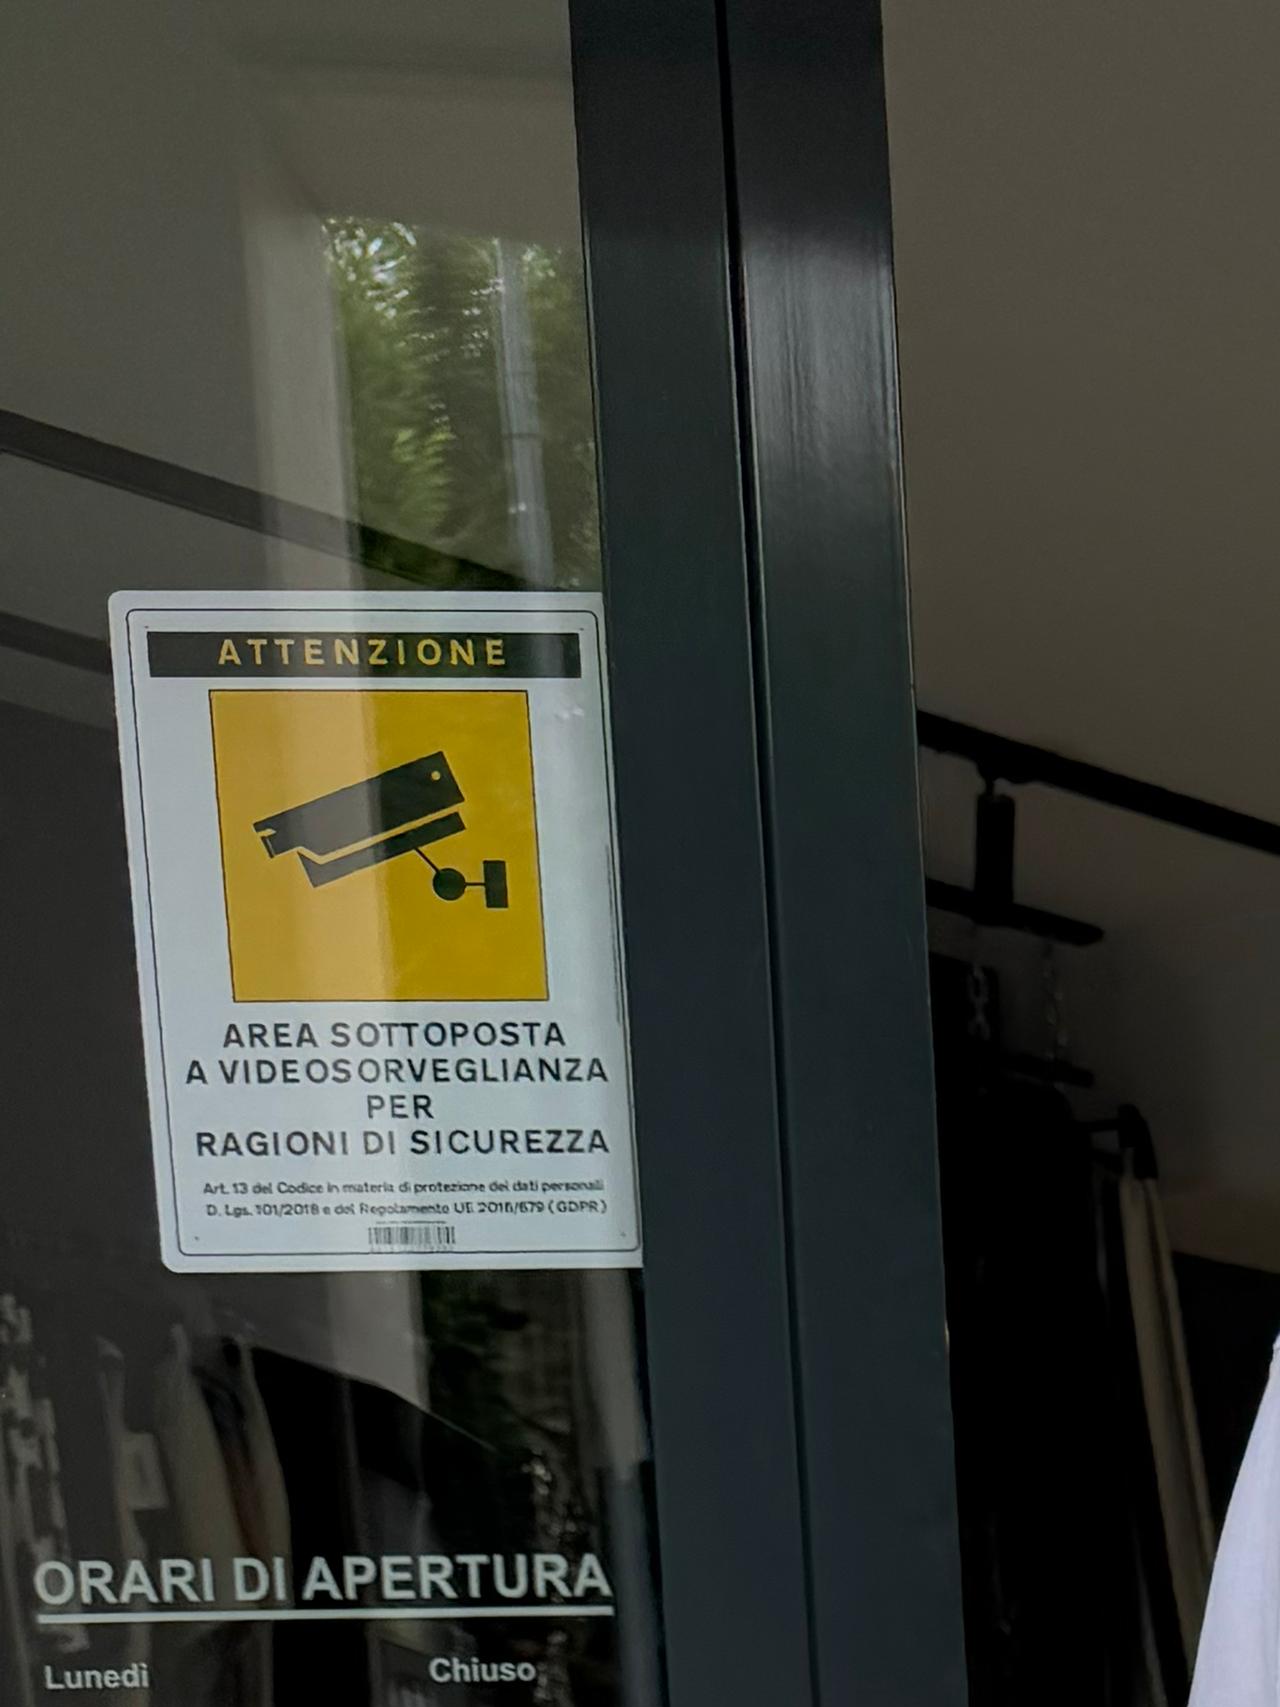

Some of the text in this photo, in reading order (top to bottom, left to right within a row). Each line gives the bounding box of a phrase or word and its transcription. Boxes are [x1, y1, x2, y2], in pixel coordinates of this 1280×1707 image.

[217, 637, 507, 667] ATTENZIONE
[223, 1021, 566, 1049] AREA SOTTOPOSTA
[185, 1057, 609, 1085] A VIDEOSORVEGLIANZA
[366, 1094, 434, 1119] PER
[196, 1129, 610, 1157] RAGIONI DI SICUREZZA
[203, 1178, 604, 1195] Art. 13 del Codice in materia di protezione dei dati personali
[206, 1204, 222, 1216] D.
[224, 1203, 253, 1218] Lgs.
[255, 1203, 319, 1217] 101/2018
[322, 1206, 331, 1215] e
[359, 1202, 450, 1216] Regolamento
[477, 1200, 545, 1215] 2016/679
[34, 1553, 613, 1605] ORARI DI APERTURA
[429, 1656, 537, 1683] Chiuso
